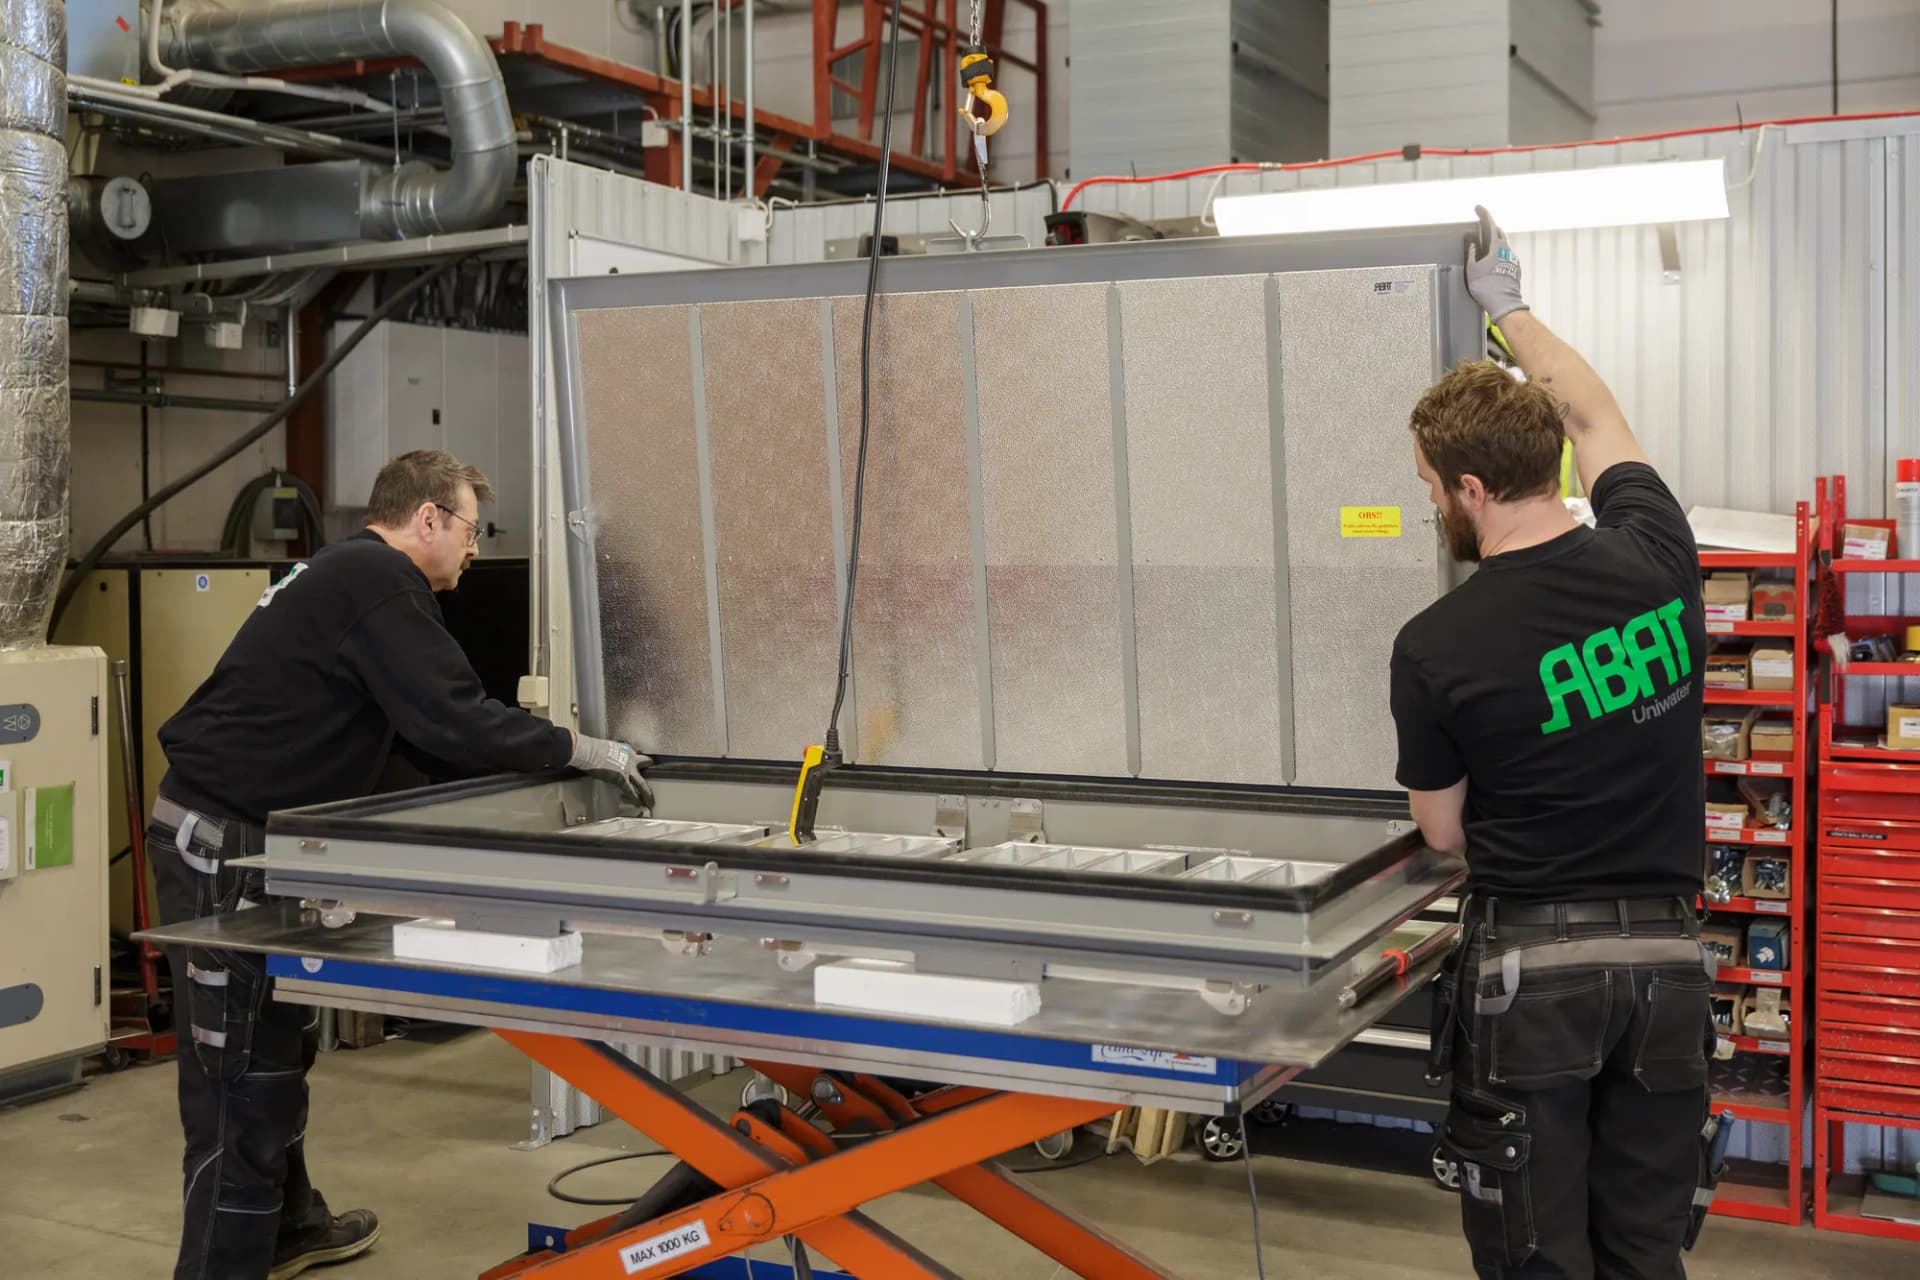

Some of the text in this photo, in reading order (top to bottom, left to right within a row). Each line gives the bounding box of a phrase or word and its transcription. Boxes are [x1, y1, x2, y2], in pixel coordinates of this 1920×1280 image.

[1539, 596, 1692, 735] ABAT
[1632, 681, 1692, 724] Uniwater
[630, 1230, 701, 1265] MAX 1000 KG
